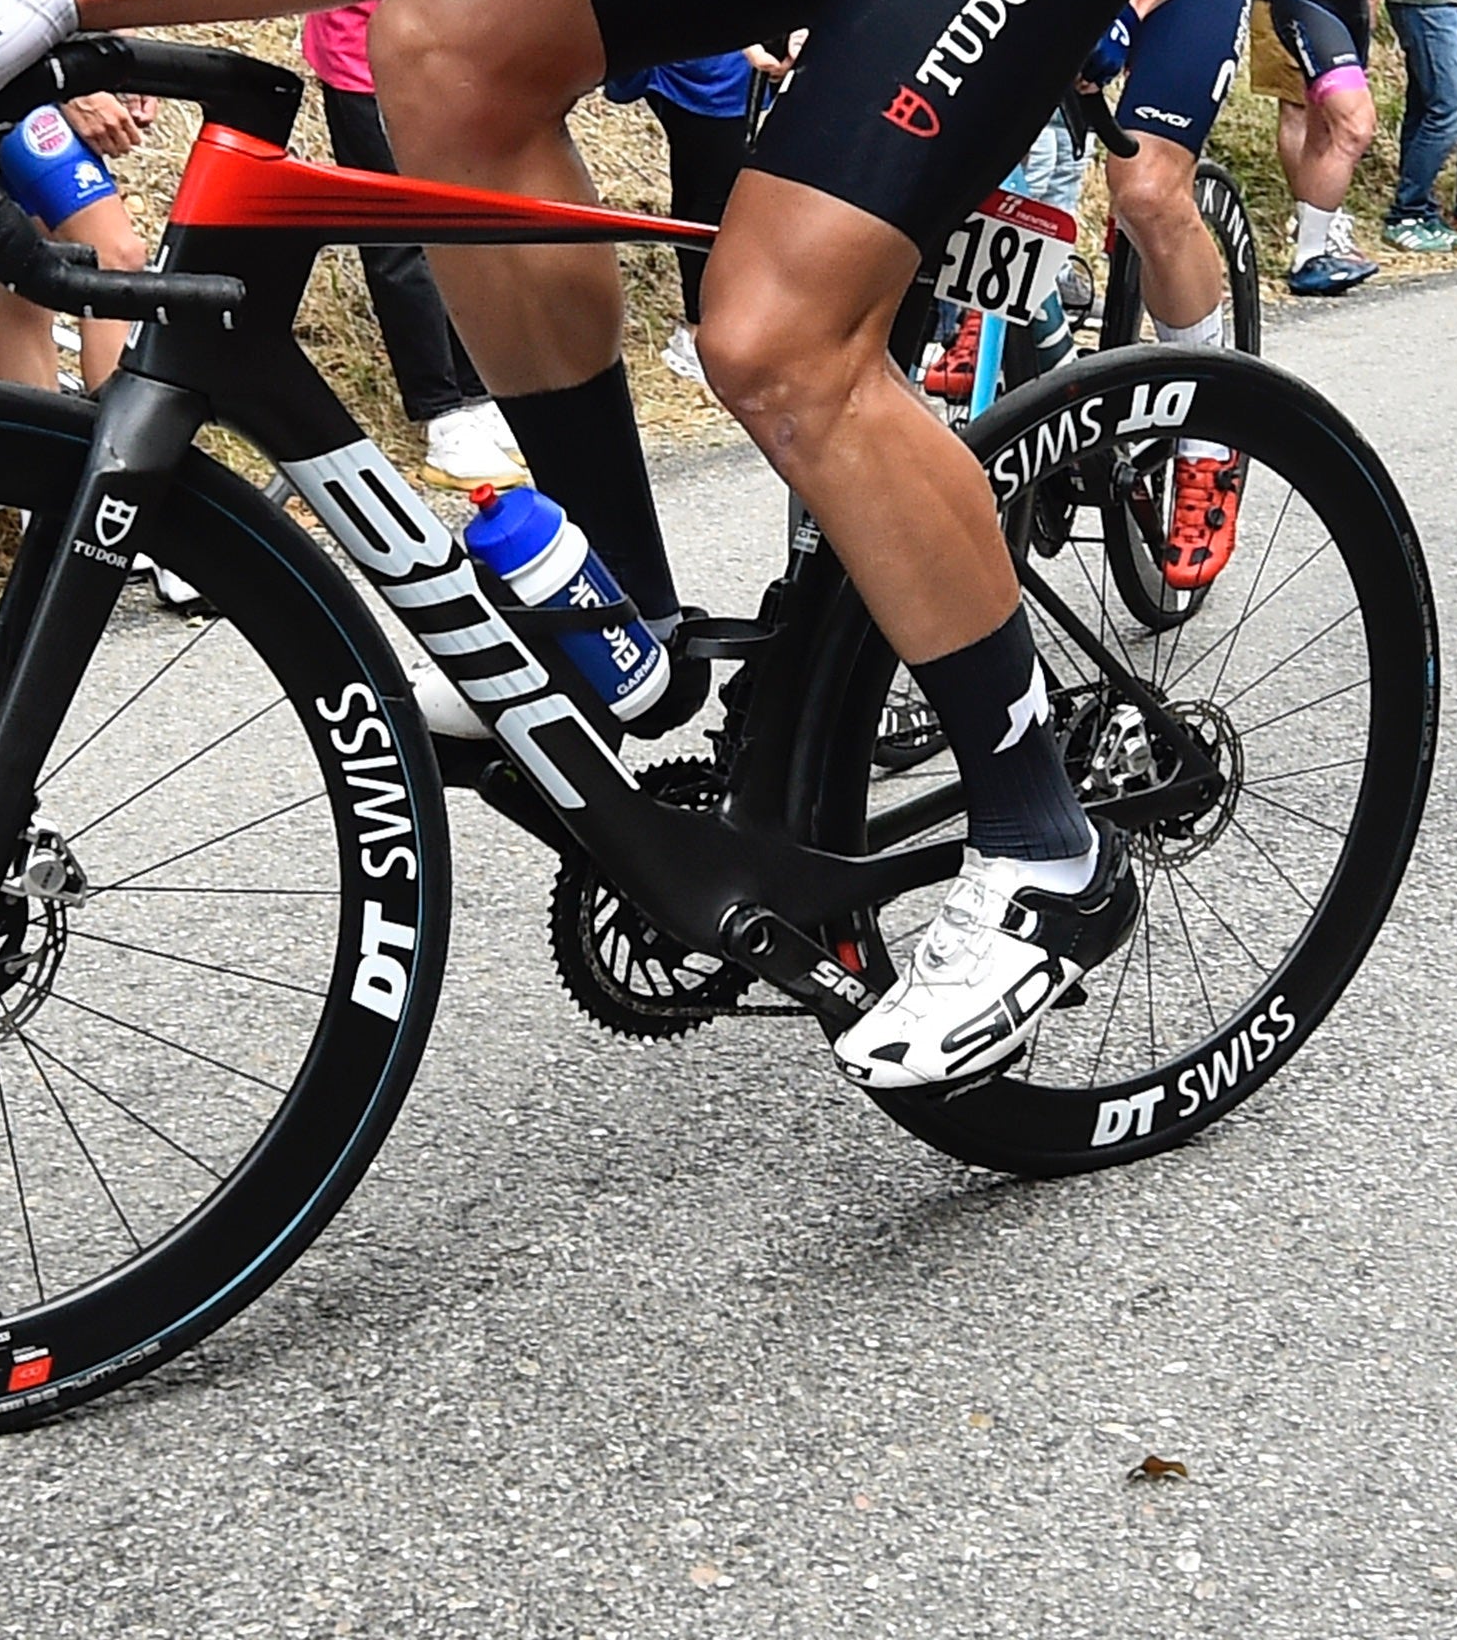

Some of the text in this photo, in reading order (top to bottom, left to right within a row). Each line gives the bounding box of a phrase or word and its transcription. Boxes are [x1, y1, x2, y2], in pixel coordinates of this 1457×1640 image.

[946, 218, 1044, 322] 181
[985, 381, 1197, 502] DT SWIS
[73, 539, 128, 570] TUDOR
[282, 438, 640, 808] BMC
[617, 645, 659, 695] GARMIN
[315, 682, 417, 1022] DT SWISS
[1091, 995, 1295, 1147] DT SWISS
